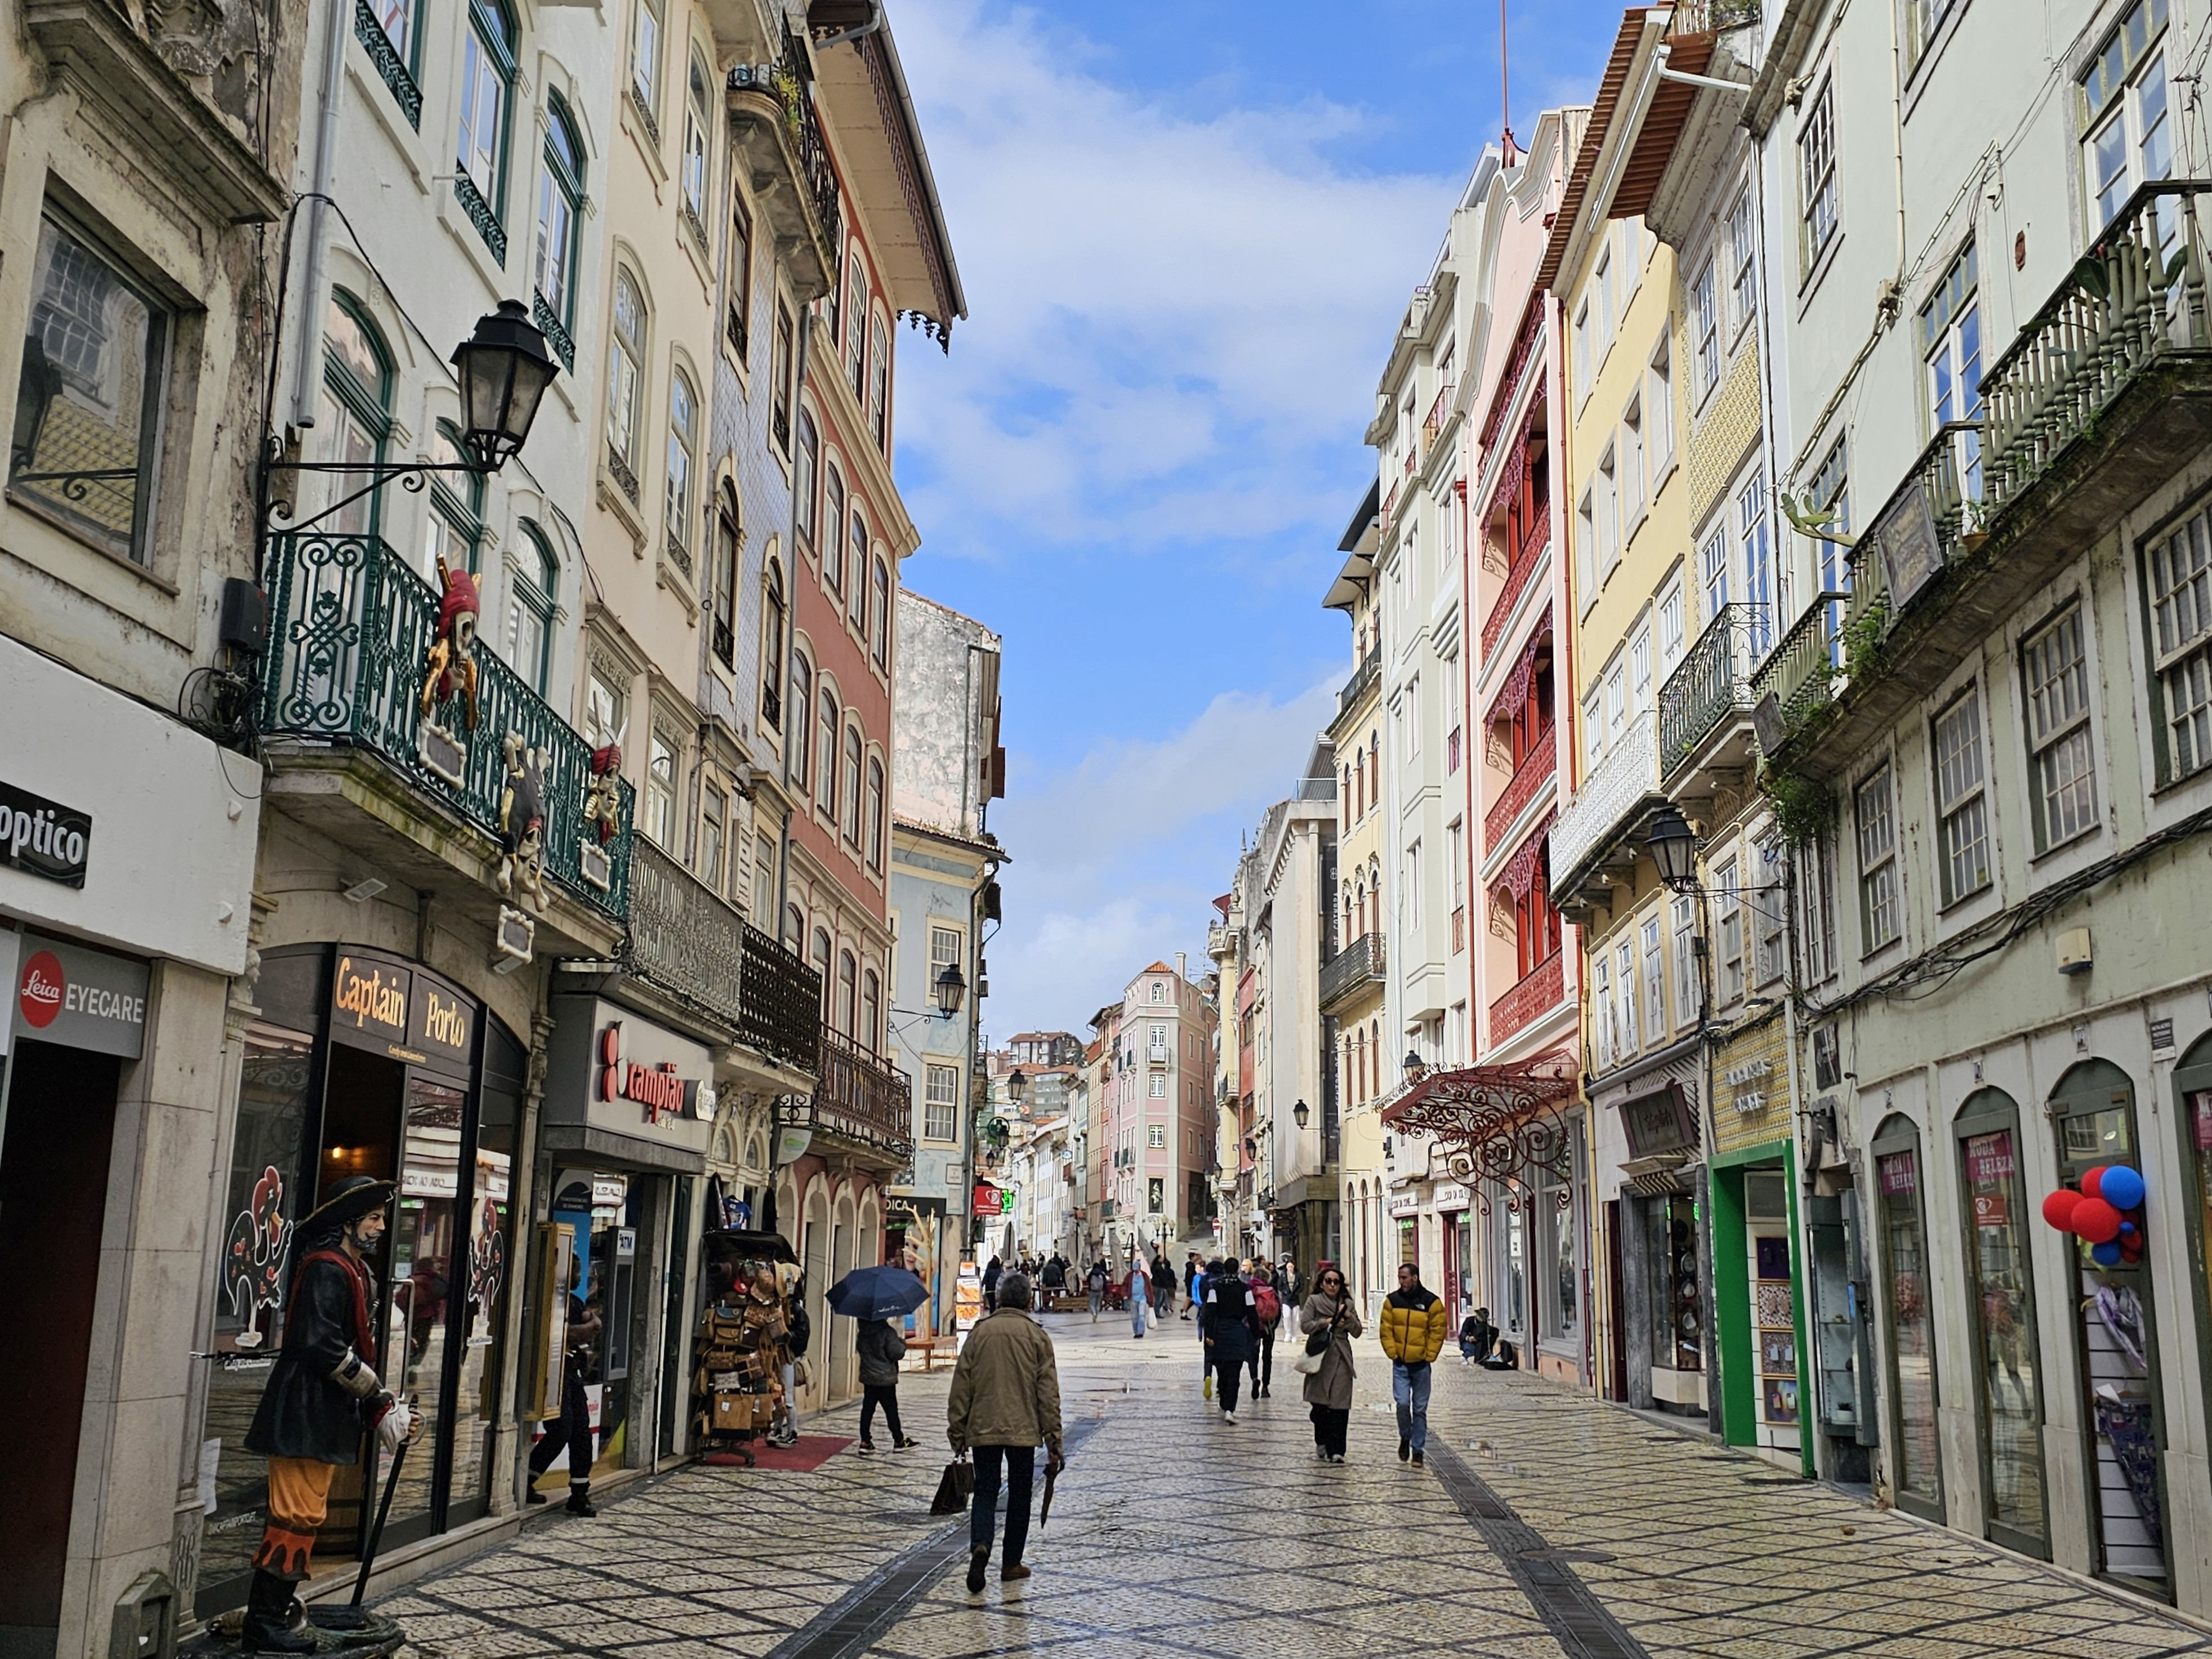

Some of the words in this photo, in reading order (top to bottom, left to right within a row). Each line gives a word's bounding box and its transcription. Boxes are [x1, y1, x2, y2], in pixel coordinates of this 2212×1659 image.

[21, 969, 60, 1004] Leica
[65, 983, 144, 1024] EYECARE
[336, 957, 405, 1028] Captain
[425, 992, 465, 1048] Porto
[1969, 1141, 1995, 1158] MODA
[1979, 1155, 2015, 1175] BELEZA
[173, 1532, 195, 1590] 86
